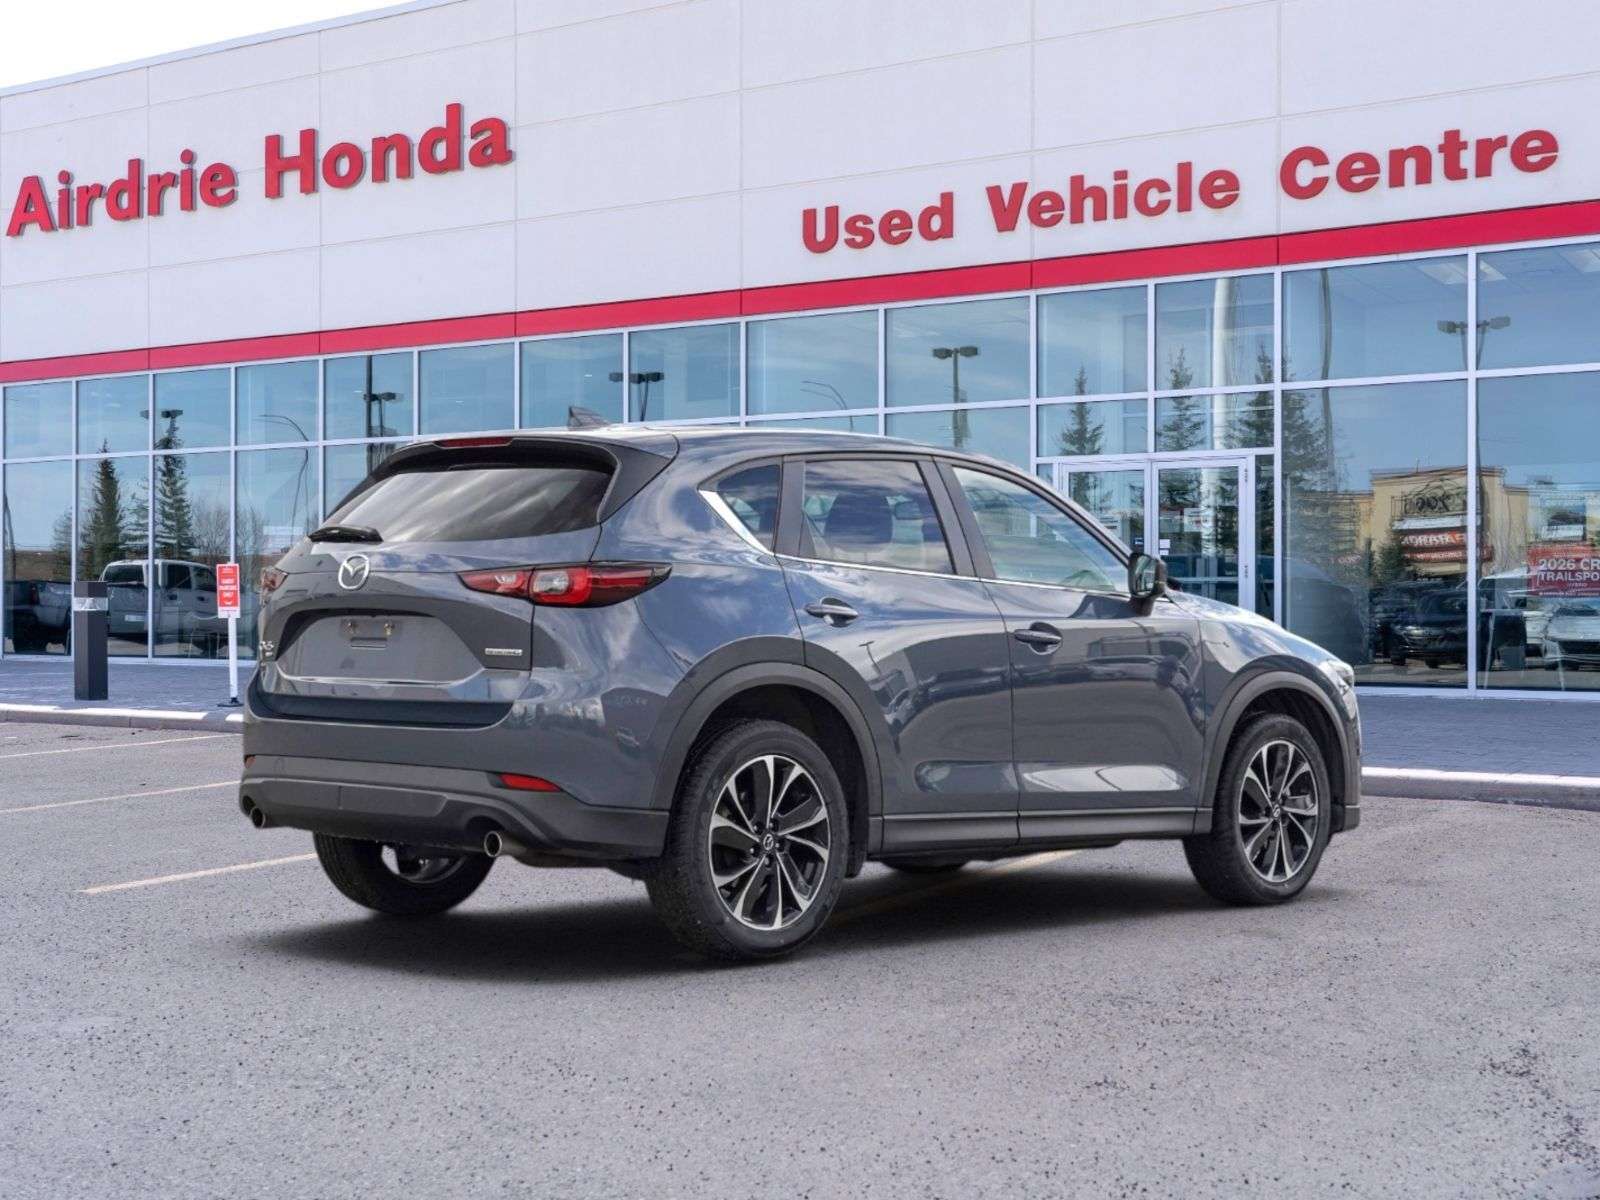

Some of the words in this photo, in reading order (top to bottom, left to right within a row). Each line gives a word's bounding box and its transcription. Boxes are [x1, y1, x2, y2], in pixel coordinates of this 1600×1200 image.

[6, 150, 237, 237] Airdrie
[264, 102, 513, 199] Honda
[802, 191, 954, 254] Used
[986, 161, 1240, 233] Vehicle
[1279, 129, 1559, 200] Centre
[1539, 558, 1576, 571] 2026
